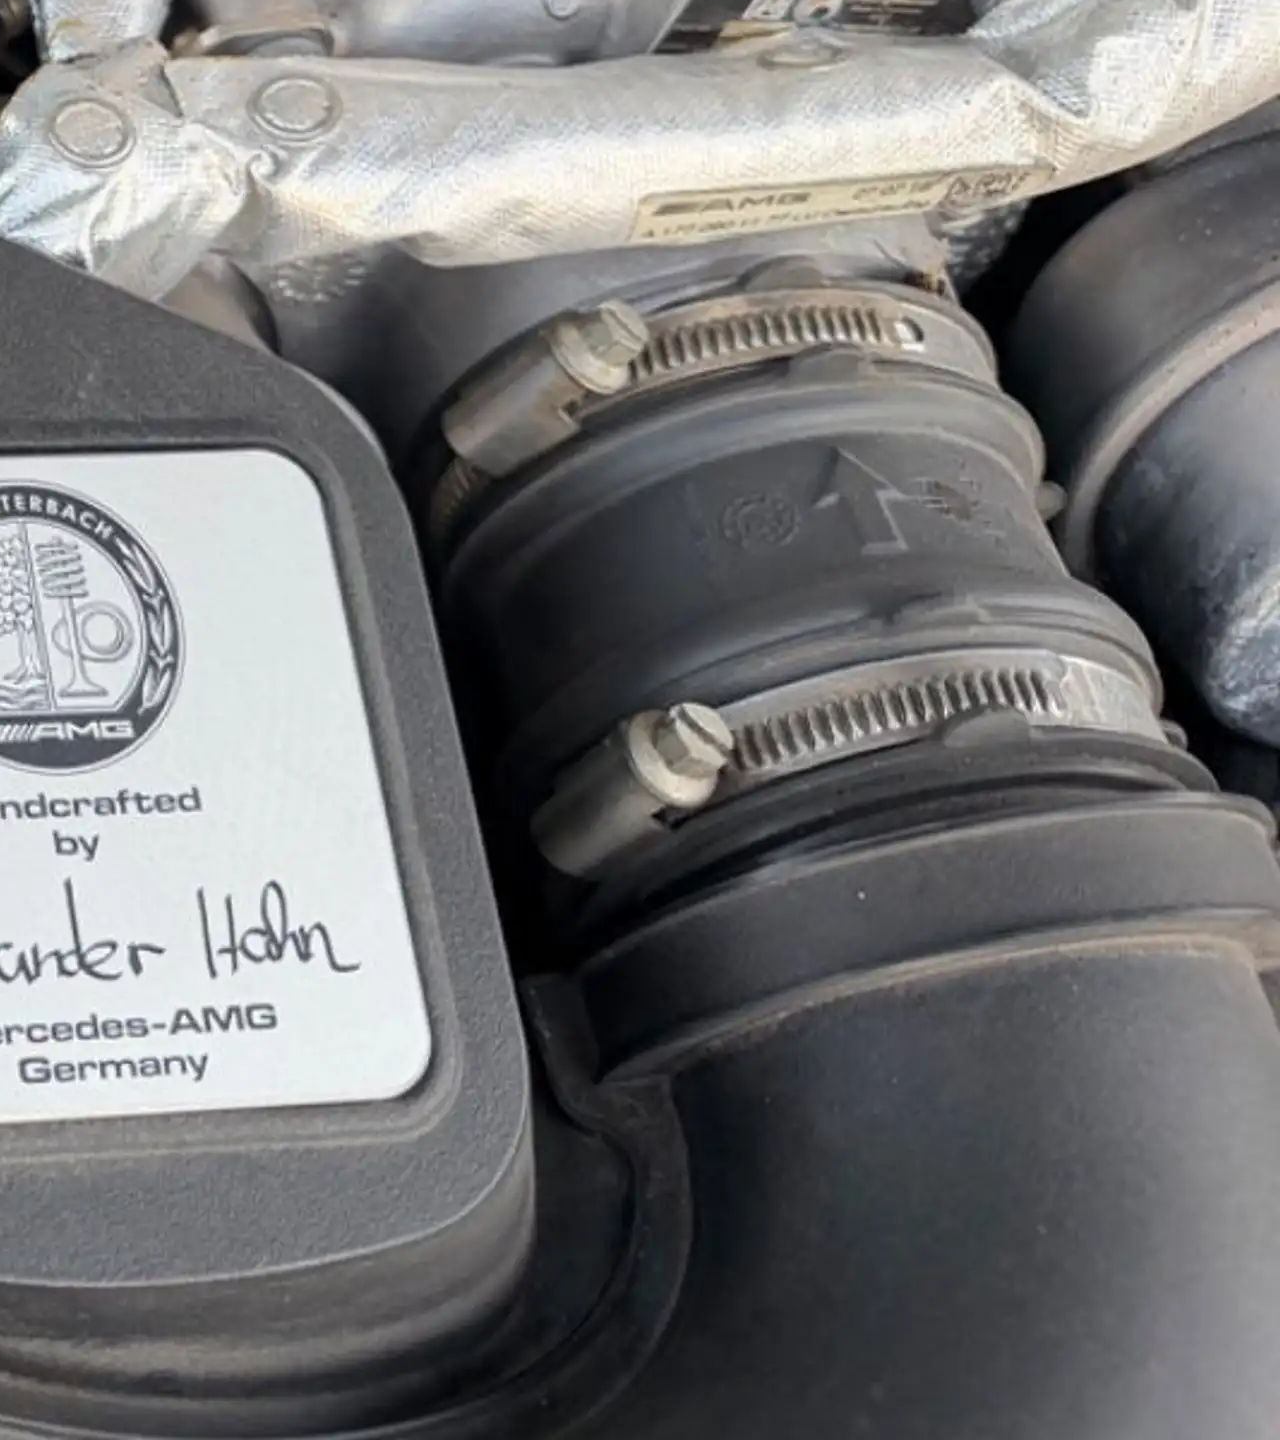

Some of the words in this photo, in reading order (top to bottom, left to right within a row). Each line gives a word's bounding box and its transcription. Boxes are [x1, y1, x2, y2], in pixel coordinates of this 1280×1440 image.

[32, 718, 137, 742] AMG
[52, 830, 100, 860] by
[19, 1053, 209, 1085] Germany
